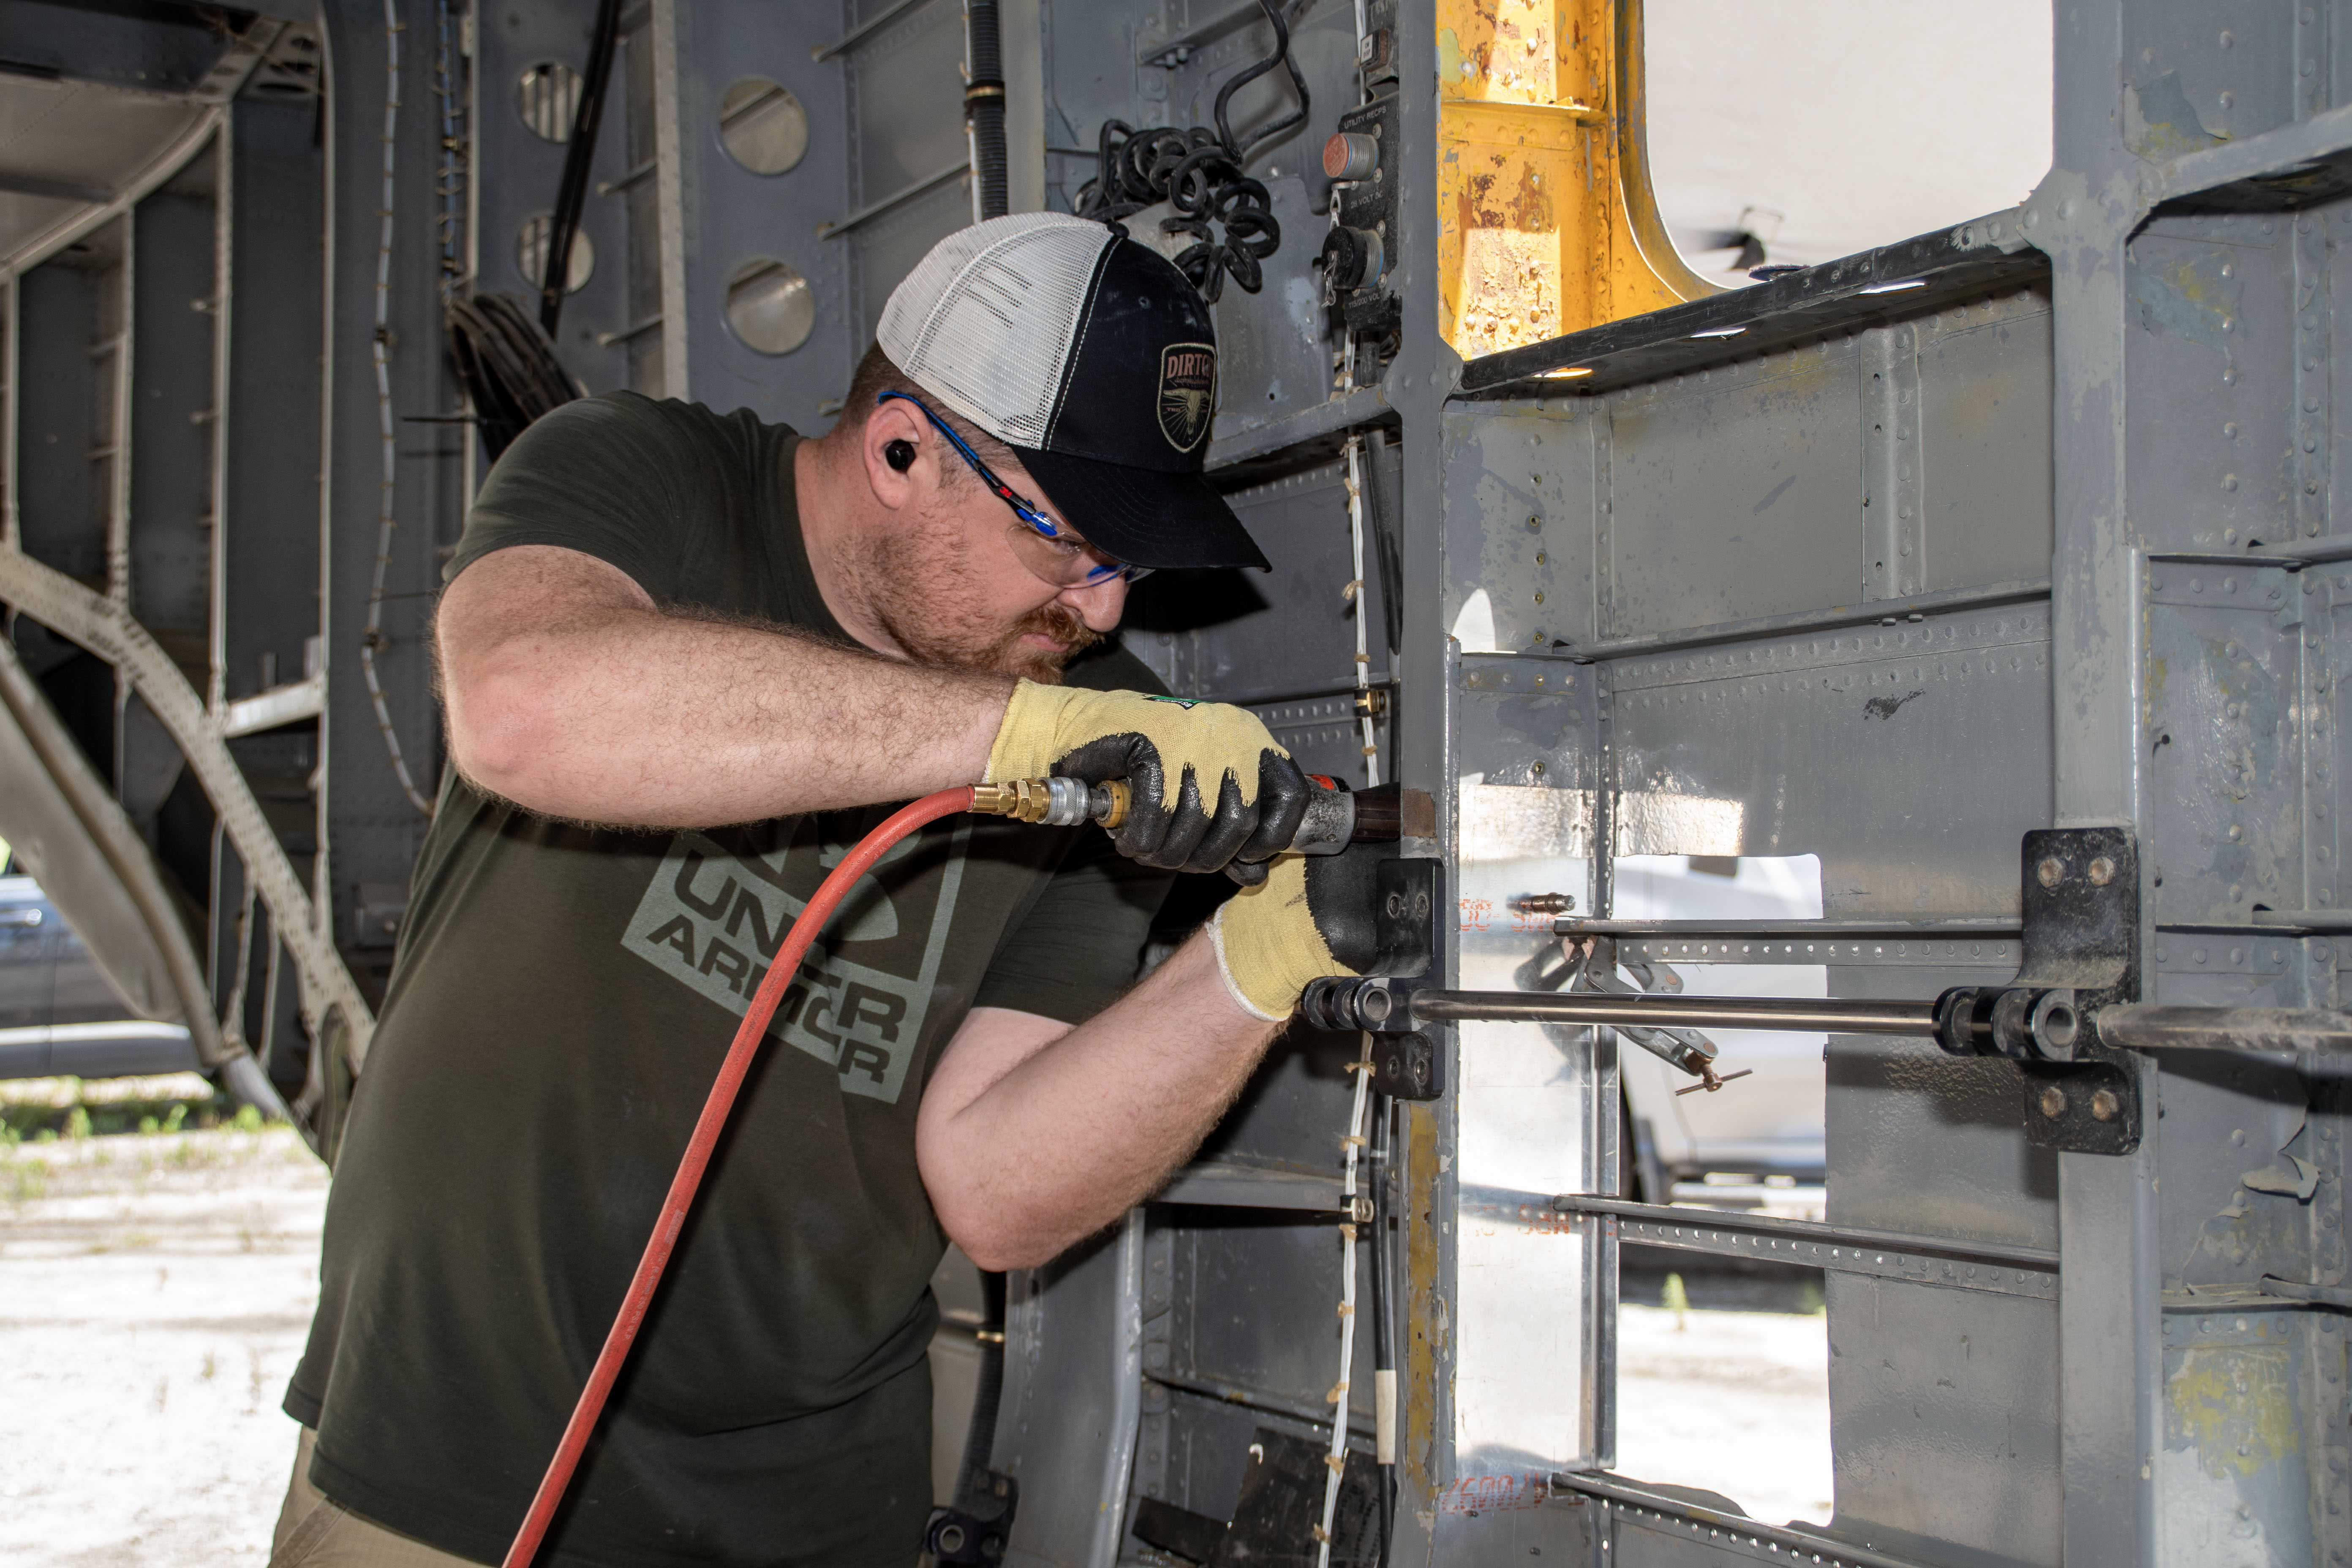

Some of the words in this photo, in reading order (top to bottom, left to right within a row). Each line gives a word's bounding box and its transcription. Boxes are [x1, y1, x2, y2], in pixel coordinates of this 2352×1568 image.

[1344, 114, 1365, 129] UTILITY
[1367, 105, 1386, 120] RECPS
[1351, 199, 1357, 209] 28
[1359, 193, 1374, 205] VOLT
[1348, 297, 1368, 308] 115/200
[999, 486, 1012, 498] 3M
[901, 825, 913, 837] 250
[887, 835, 900, 847] PSI
[674, 849, 907, 1043] UNR
